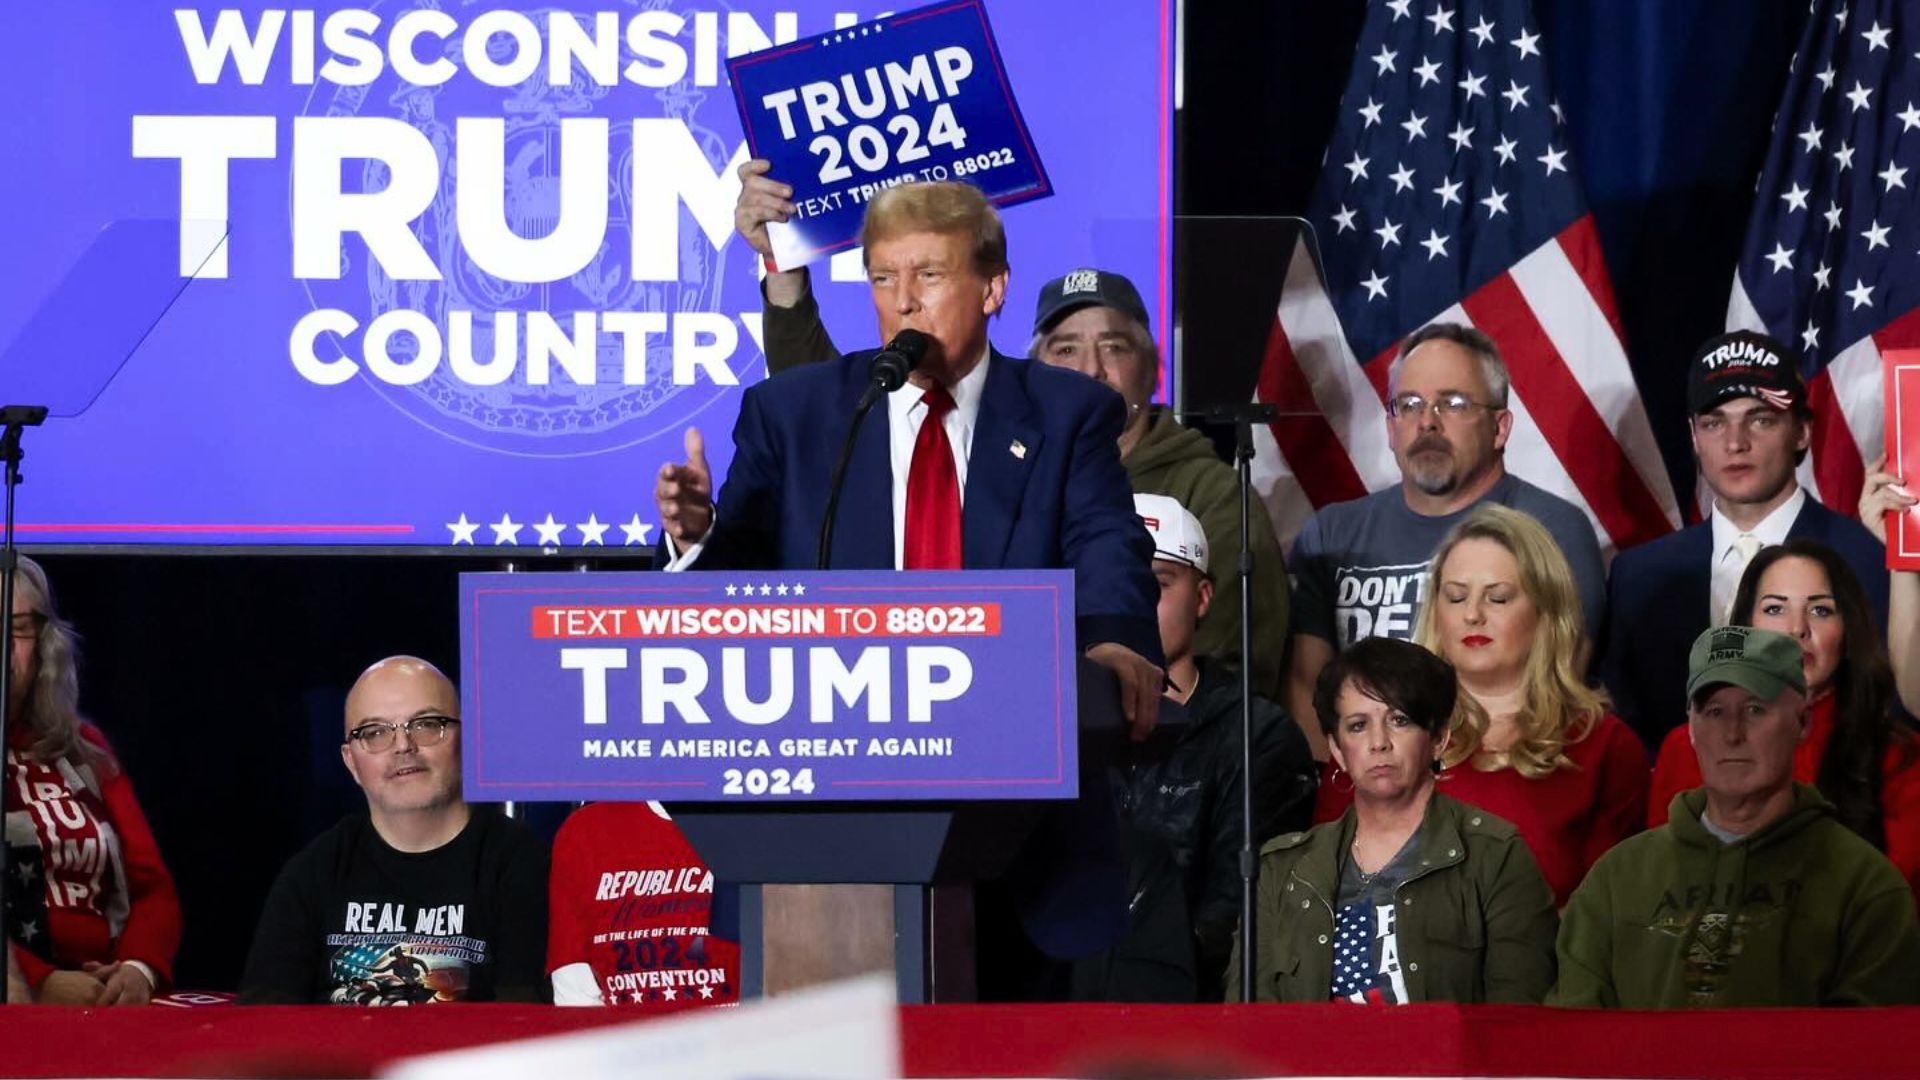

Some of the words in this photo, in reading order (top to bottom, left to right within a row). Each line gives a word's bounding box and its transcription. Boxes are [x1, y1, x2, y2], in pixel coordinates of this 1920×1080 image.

[762, 46, 974, 140] TRUMP
[808, 103, 967, 184] 2024
[132, 115, 868, 283] TRUM
[796, 192, 843, 219] TEXT
[920, 165, 948, 183] TO
[953, 148, 1016, 177] 88022
[1702, 341, 1780, 370] TRUMP
[1337, 572, 1432, 607] DON'T
[547, 609, 627, 635] TEXT
[636, 608, 825, 635] WISCONSIN
[834, 608, 877, 634] TO
[886, 607, 986, 633] 88022
[560, 645, 973, 725] TRUMP
[583, 739, 652, 758] MAKE
[660, 739, 771, 758] AMERICA
[779, 738, 858, 757] GREAT
[866, 737, 953, 757] AGAIN!
[722, 768, 815, 795] 2024
[344, 900, 408, 934] REAL
[414, 903, 465, 936] MEN
[627, 928, 649, 940] LIFE
[667, 926, 687, 937] THE
[612, 936, 708, 972] 2024
[606, 967, 726, 992] CONVENTION
